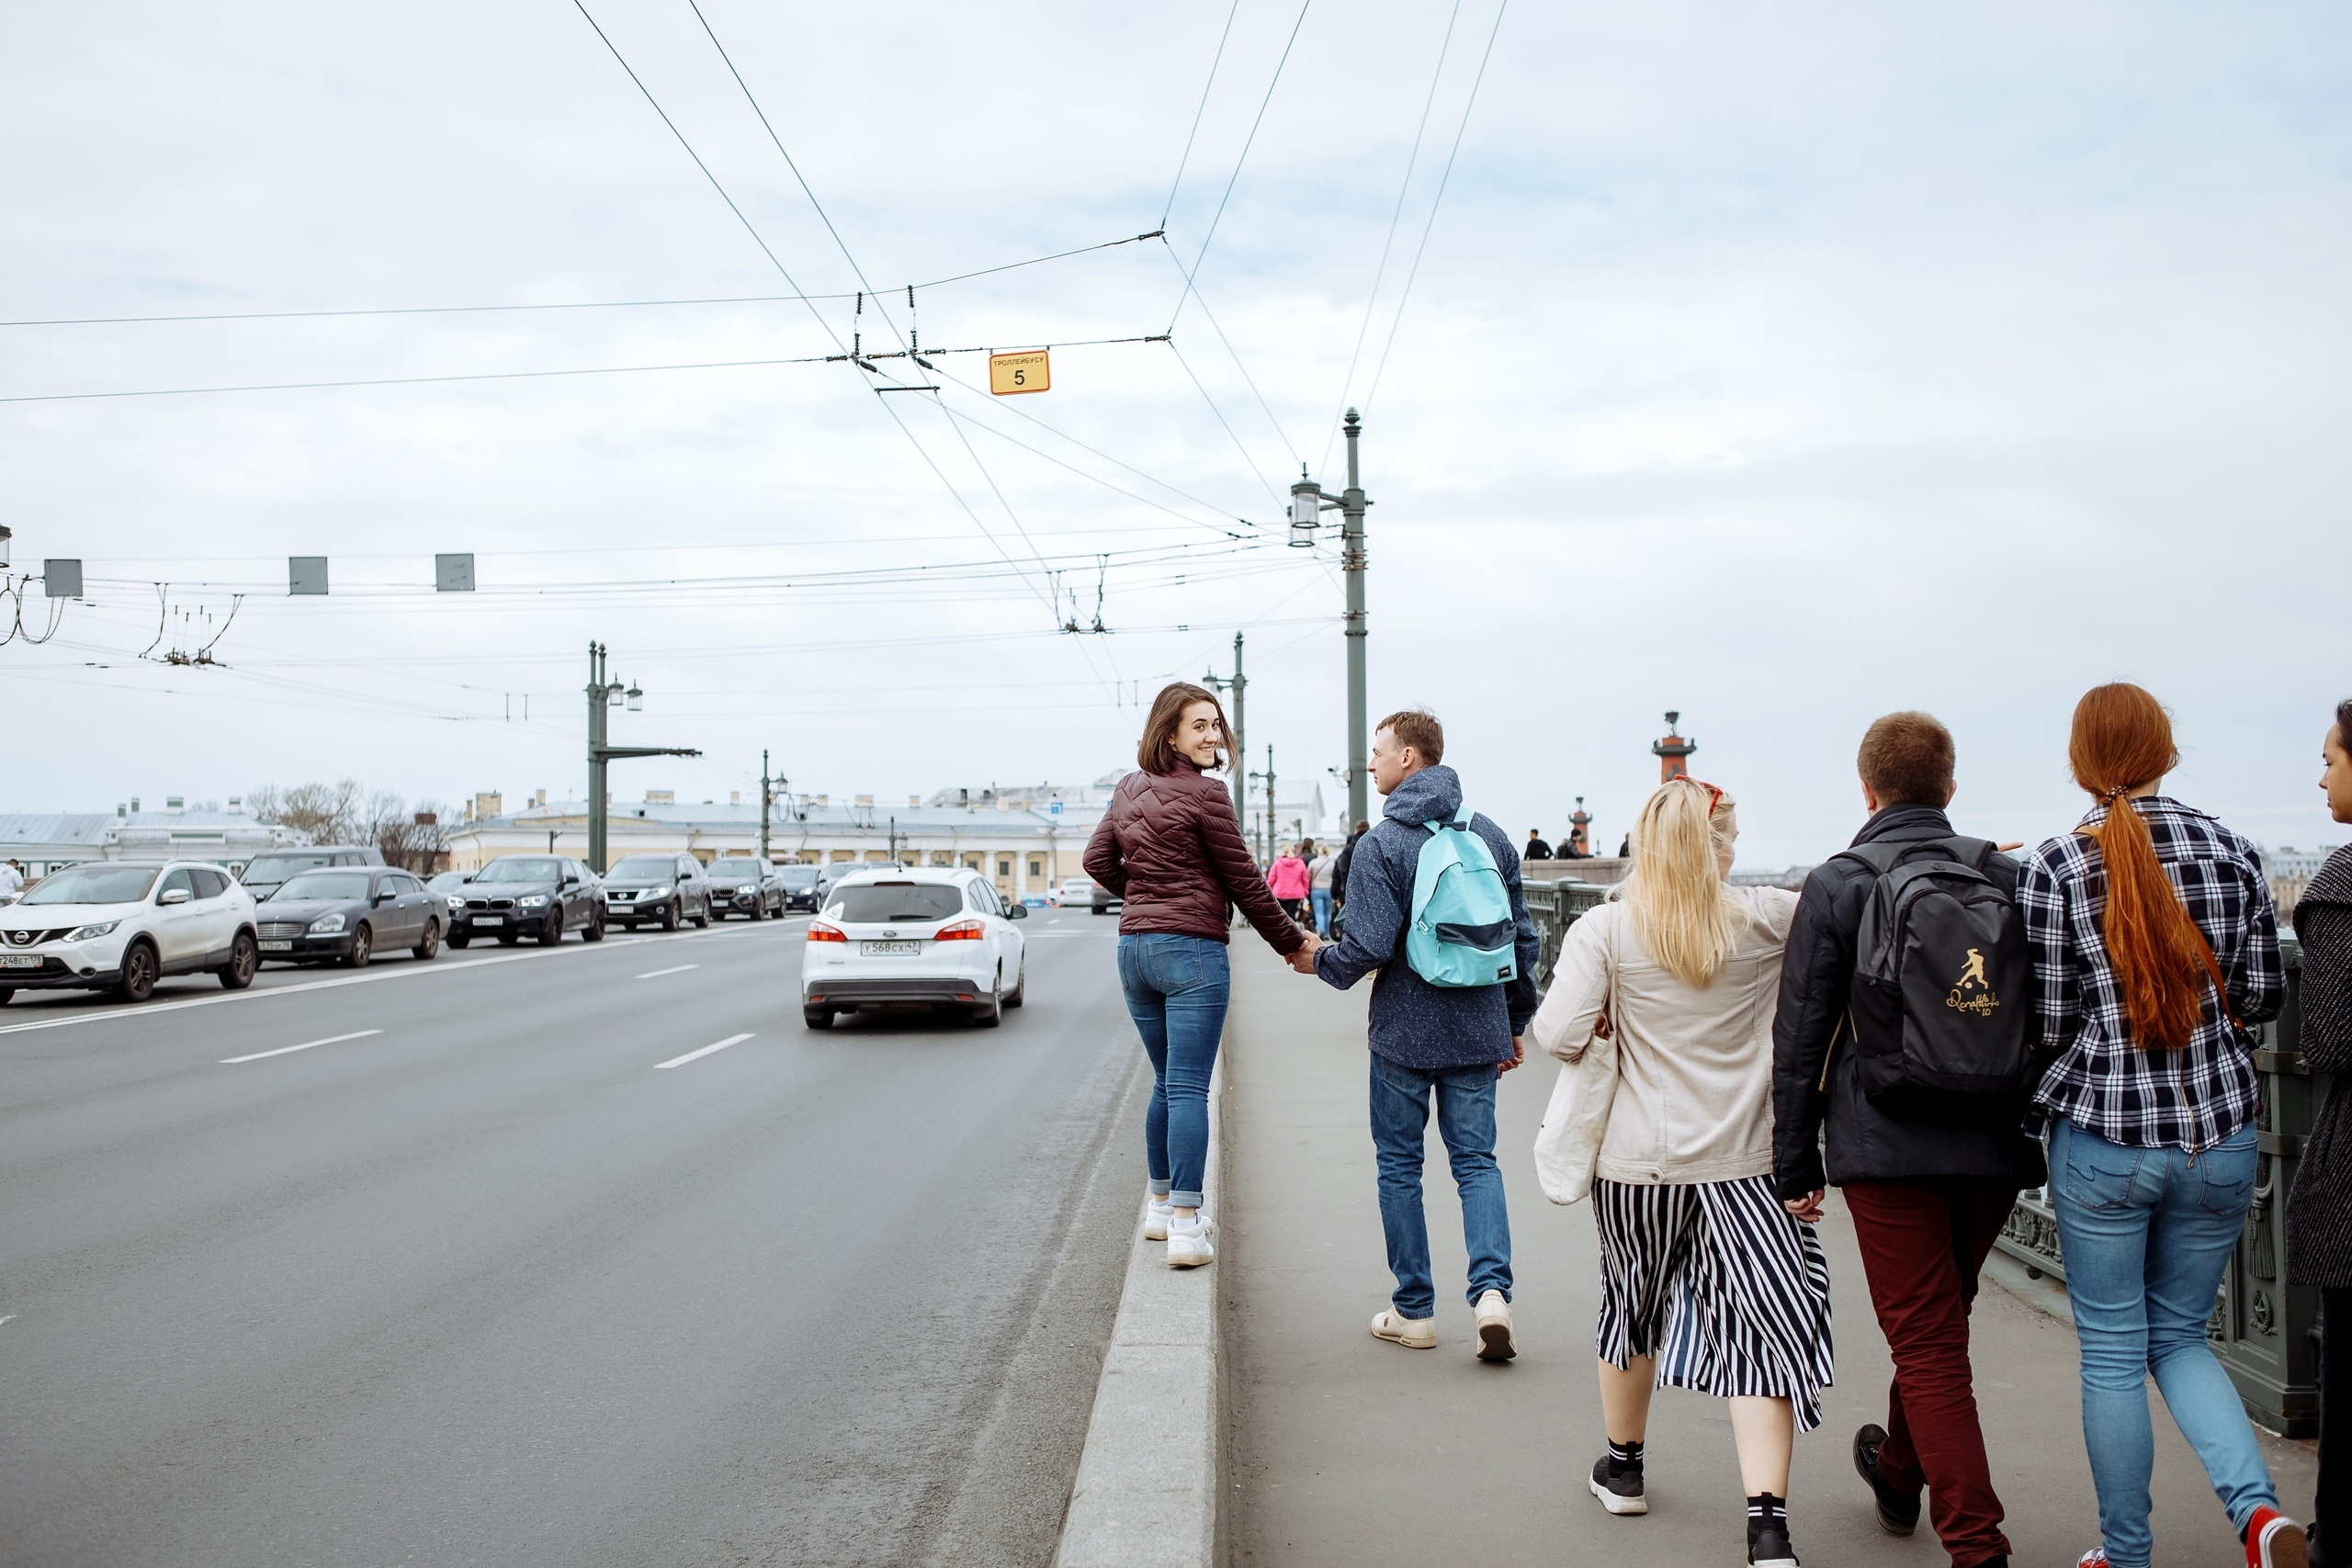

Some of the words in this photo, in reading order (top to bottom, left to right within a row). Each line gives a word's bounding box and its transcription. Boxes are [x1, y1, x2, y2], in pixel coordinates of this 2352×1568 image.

[993, 356, 1045, 367] ТРОЛЛЕЙБУСУ
[1014, 369, 1025, 386] 5
[1982, 1008, 1992, 1017] 10
